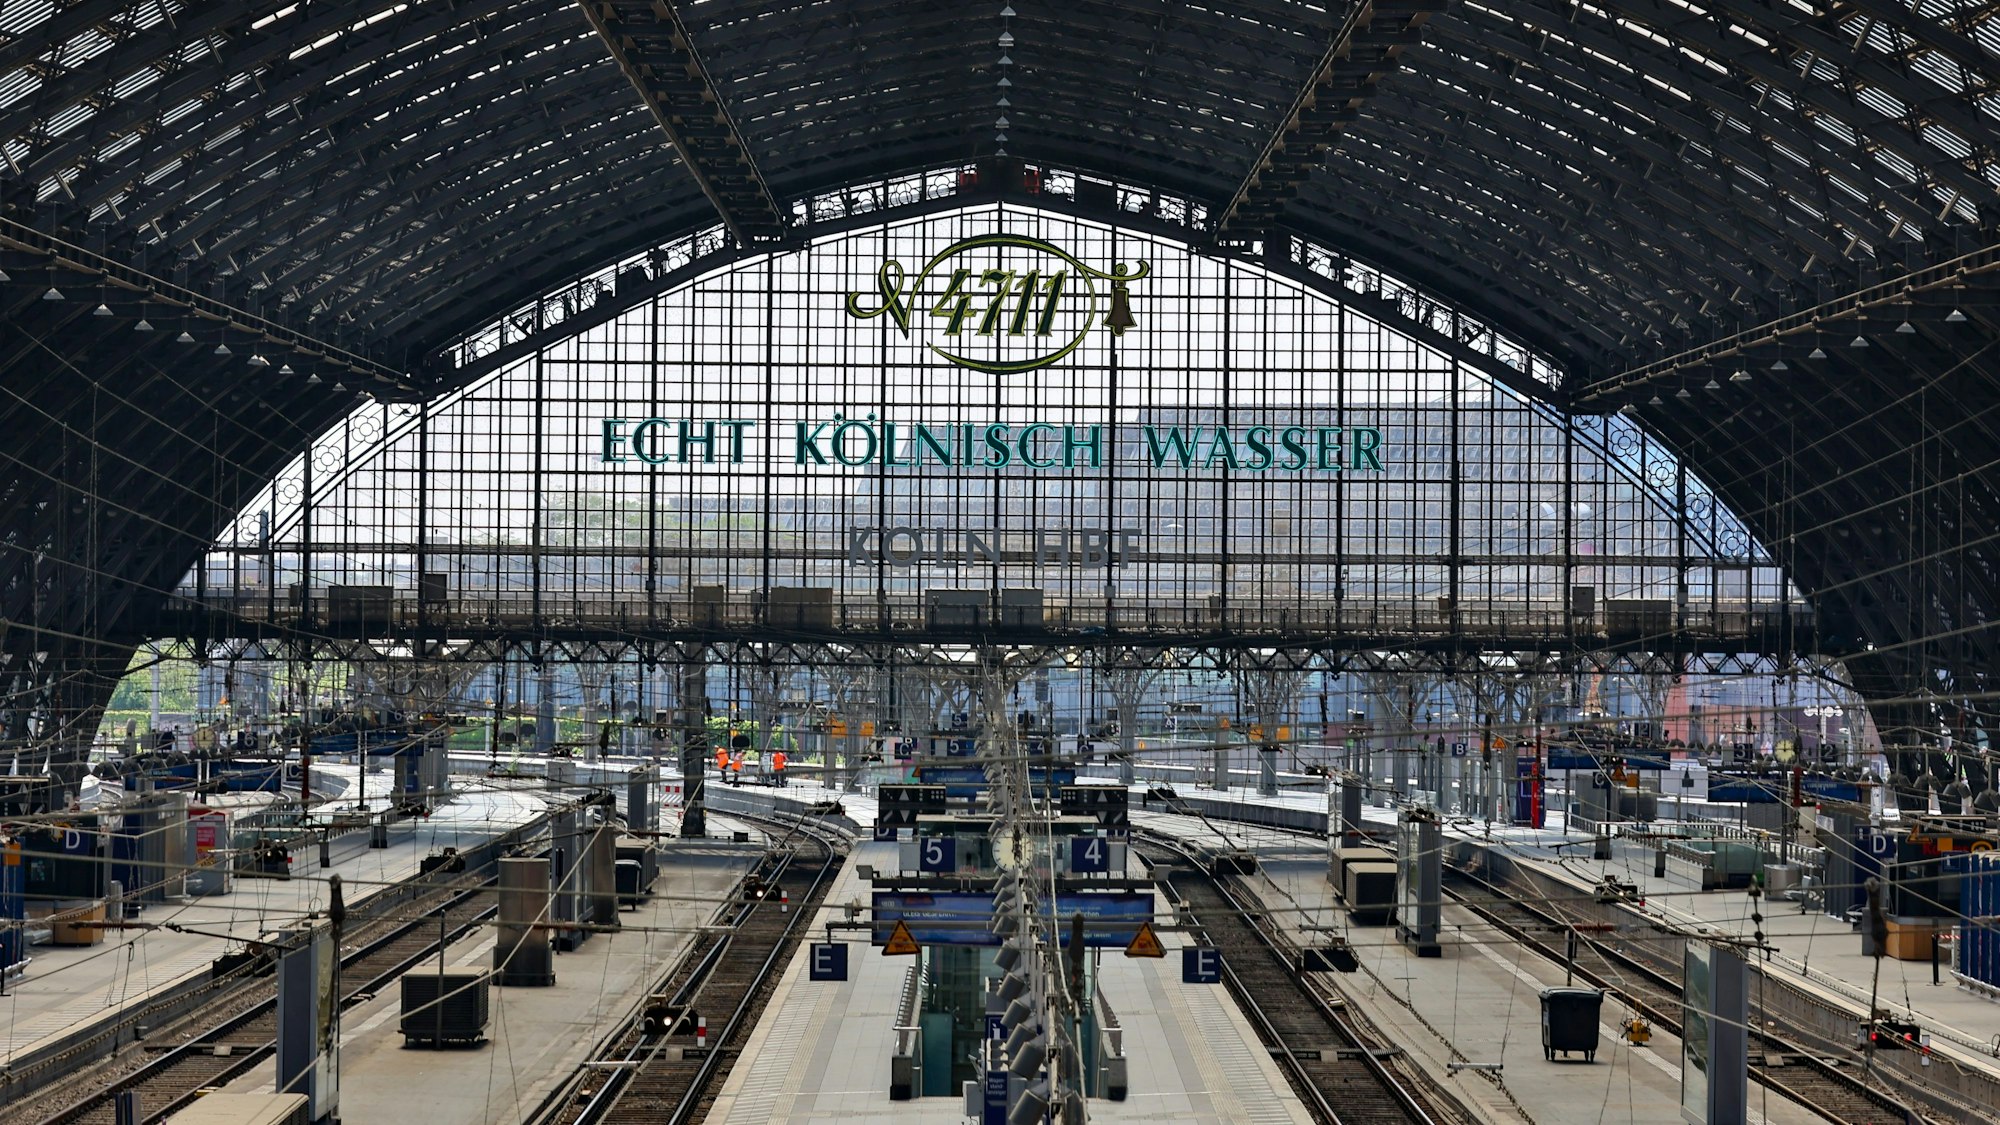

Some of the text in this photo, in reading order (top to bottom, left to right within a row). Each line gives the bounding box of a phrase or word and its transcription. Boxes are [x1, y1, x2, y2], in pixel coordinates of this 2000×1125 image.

[928, 268, 1066, 338] 4711
[600, 412, 1385, 472] ECHT KÖLNISCH WASSER
[1036, 526, 1143, 570] HBF
[244, 734, 254, 748] 6
[899, 743, 910, 756] C
[950, 739, 959, 753] 5
[1456, 744, 1464, 754] B
[1735, 744, 1746, 759] 3
[1824, 744, 1834, 760] 2
[65, 830, 80, 849] D
[1872, 835, 1887, 853] D
[925, 838, 943, 865] 5
[1084, 838, 1102, 865] 4
[814, 944, 832, 972] E
[1198, 949, 1215, 975] E
